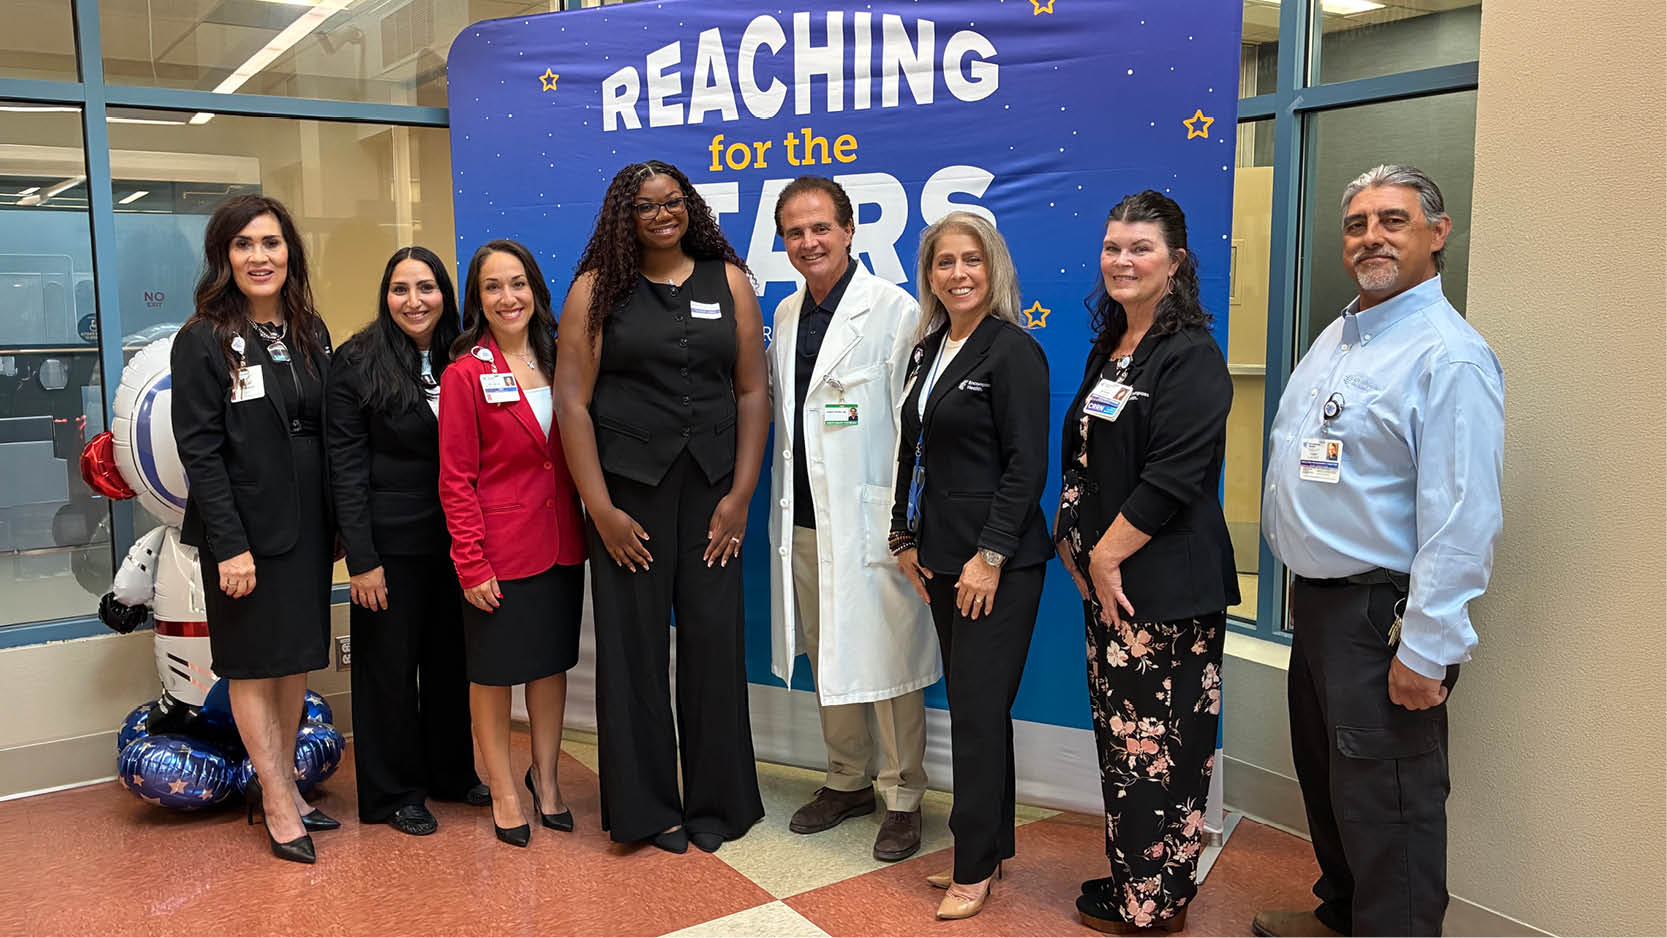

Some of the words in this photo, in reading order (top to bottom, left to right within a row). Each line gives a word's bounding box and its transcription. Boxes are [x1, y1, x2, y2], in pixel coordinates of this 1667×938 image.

[602, 11, 999, 132] REACHING
[709, 134, 772, 172] for
[784, 128, 859, 166] the
[144, 291, 165, 301] NO
